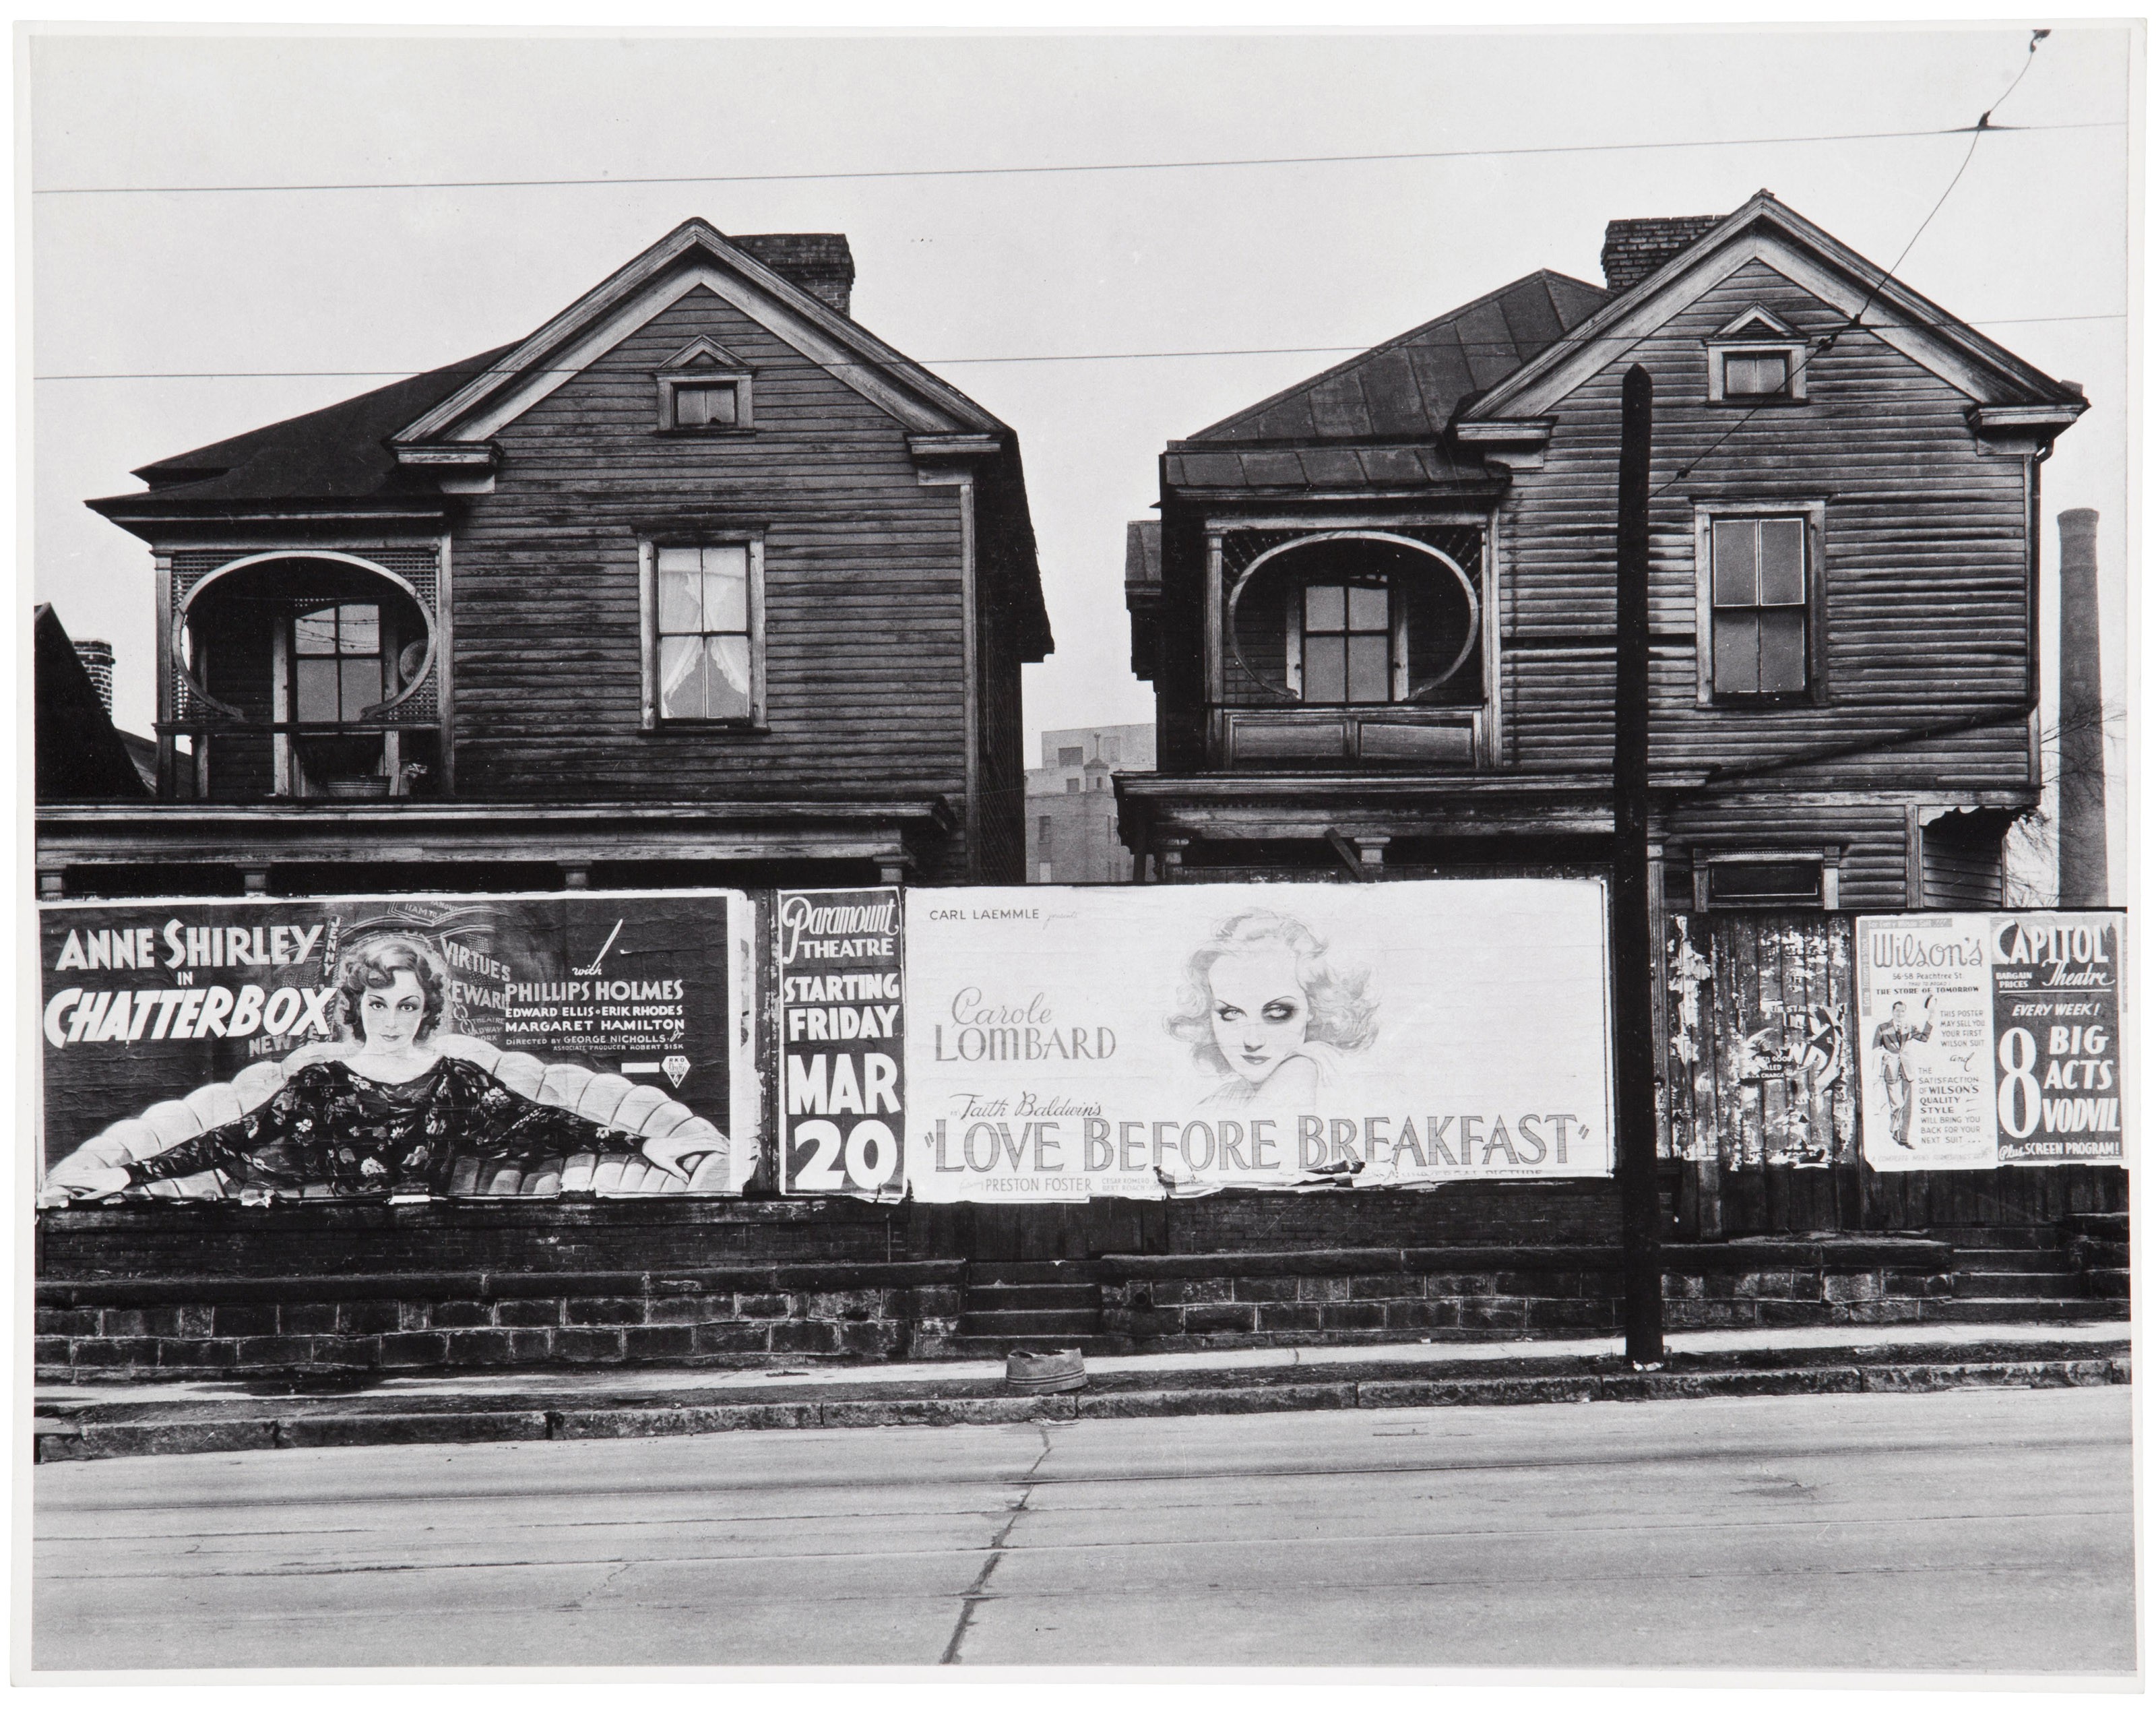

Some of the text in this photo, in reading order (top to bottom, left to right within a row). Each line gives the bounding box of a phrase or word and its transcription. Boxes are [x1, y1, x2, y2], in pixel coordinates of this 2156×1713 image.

[930, 910, 966, 920] CARL
[973, 909, 1039, 919] LAEMMLE
[55, 918, 324, 970] ANNE SHIRLEY
[782, 897, 899, 964] Paramount
[1992, 919, 2110, 964] CAPITOL
[323, 916, 341, 976] JENNY
[440, 937, 511, 983] VIRTUES
[799, 937, 895, 958] THEATRE
[1874, 933, 1983, 968] Wilson's
[177, 971, 193, 985] IN
[1916, 972, 1952, 980] Peachtree
[1996, 972, 2033, 980] BARGAIN
[2041, 958, 2116, 987] Theatre
[506, 979, 684, 1002] PHILLIPS HOLMES
[784, 973, 899, 1003] STARTING
[44, 985, 338, 1049] CHATTERBOX
[506, 1005, 683, 1018] EDWARD ELLIS ERIK RHODES
[951, 987, 1053, 1028] Carole
[2012, 1003, 2053, 1016] EVERY
[506, 1019, 685, 1032] MARGARET HAMILTON
[789, 1005, 900, 1041] FRIDAY
[249, 1034, 292, 1057] NEW
[564, 1036, 606, 1044] GEORGE
[935, 1024, 1116, 1061] LOMBARD
[2049, 1025, 2110, 1055] BIG
[1949, 1052, 1975, 1072] and
[2043, 1059, 2114, 1090] ACTS
[788, 1053, 901, 1115] MAR
[1929, 1084, 1979, 1094] WILSON'S
[1998, 1027, 2041, 1139] 8
[949, 1093, 1009, 1119] Faith
[1015, 1090, 1102, 1117] Baldwin's
[1920, 1096, 1961, 1106] QUALITY
[2041, 1097, 2121, 1133] VODVIL
[794, 1119, 898, 1190] 20
[1083, 1117, 1281, 1173] BEFORE
[1922, 1136, 1940, 1144] NEXT
[1998, 1142, 2120, 1161] Plus SCREEN PROGRAM!
[986, 1178, 1039, 1192] PRESTON
[1045, 1177, 1093, 1191] FOSTER
